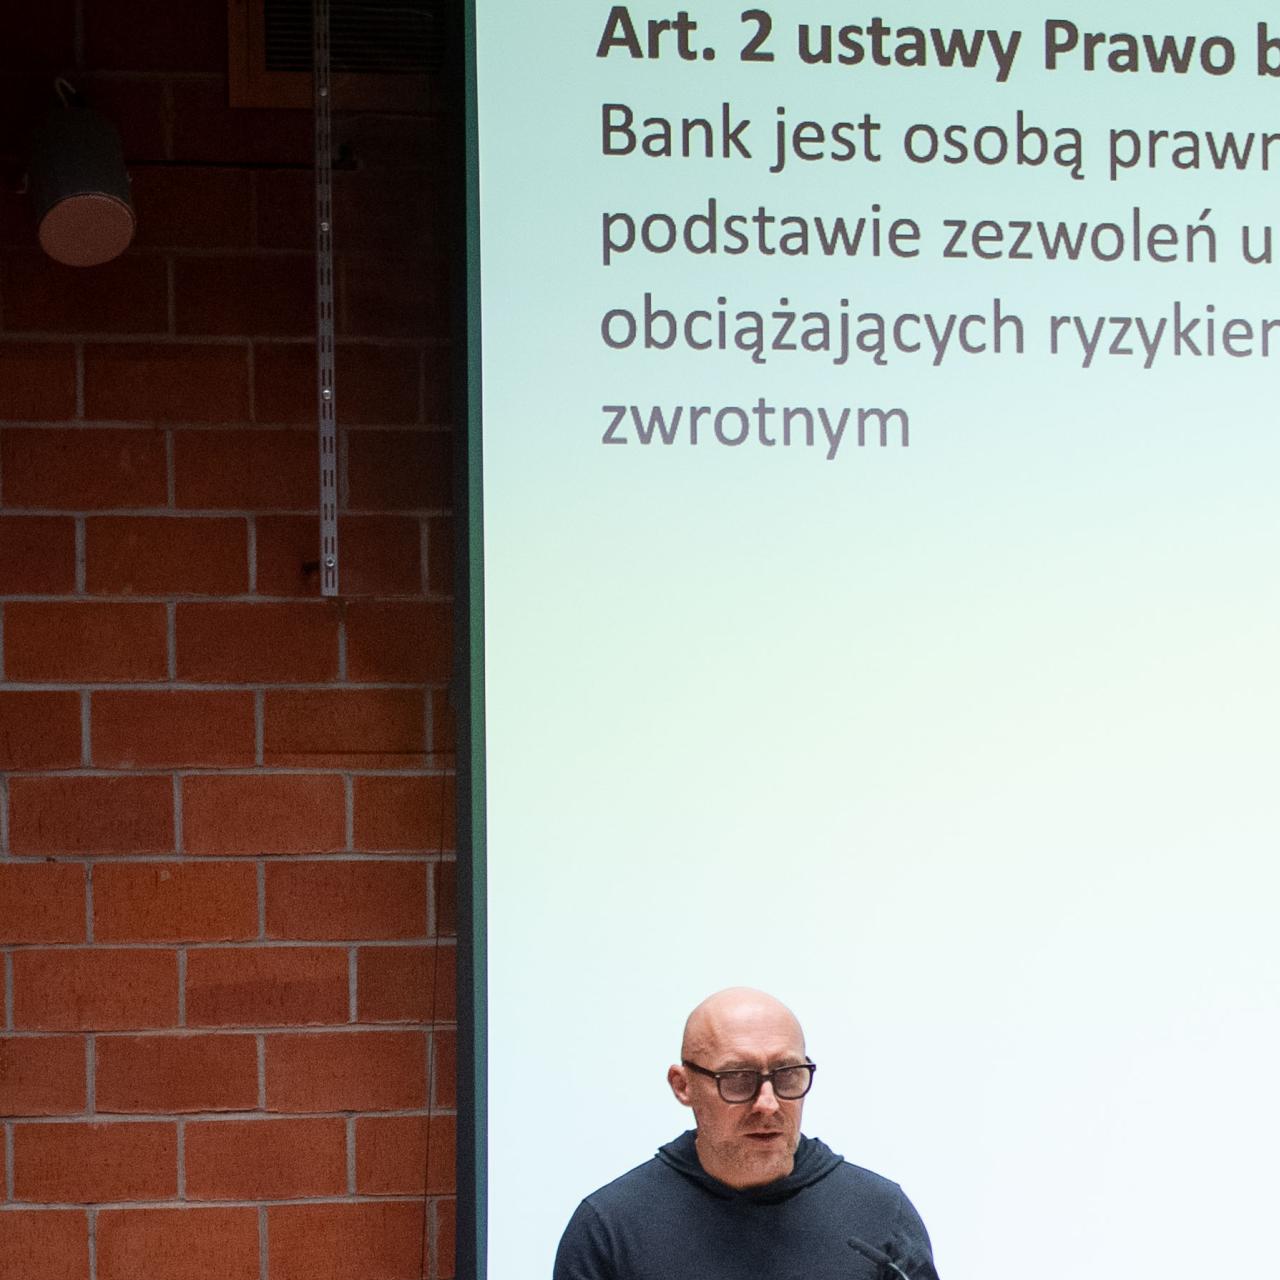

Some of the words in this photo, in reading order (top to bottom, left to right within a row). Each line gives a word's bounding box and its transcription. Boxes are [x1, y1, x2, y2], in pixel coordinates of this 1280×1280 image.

[595, 4, 716, 62] Art.
[739, 7, 776, 63] 2
[797, 15, 1023, 83] ustawy
[1044, 18, 1237, 77] Prawo
[601, 101, 753, 160] Bank
[768, 105, 883, 174] jest
[903, 109, 1086, 181] osobą
[602, 196, 922, 267] podstawie
[942, 205, 1217, 264] zezwoleń
[600, 291, 1025, 367] obciążających
[601, 396, 910, 461] zwrotnym
